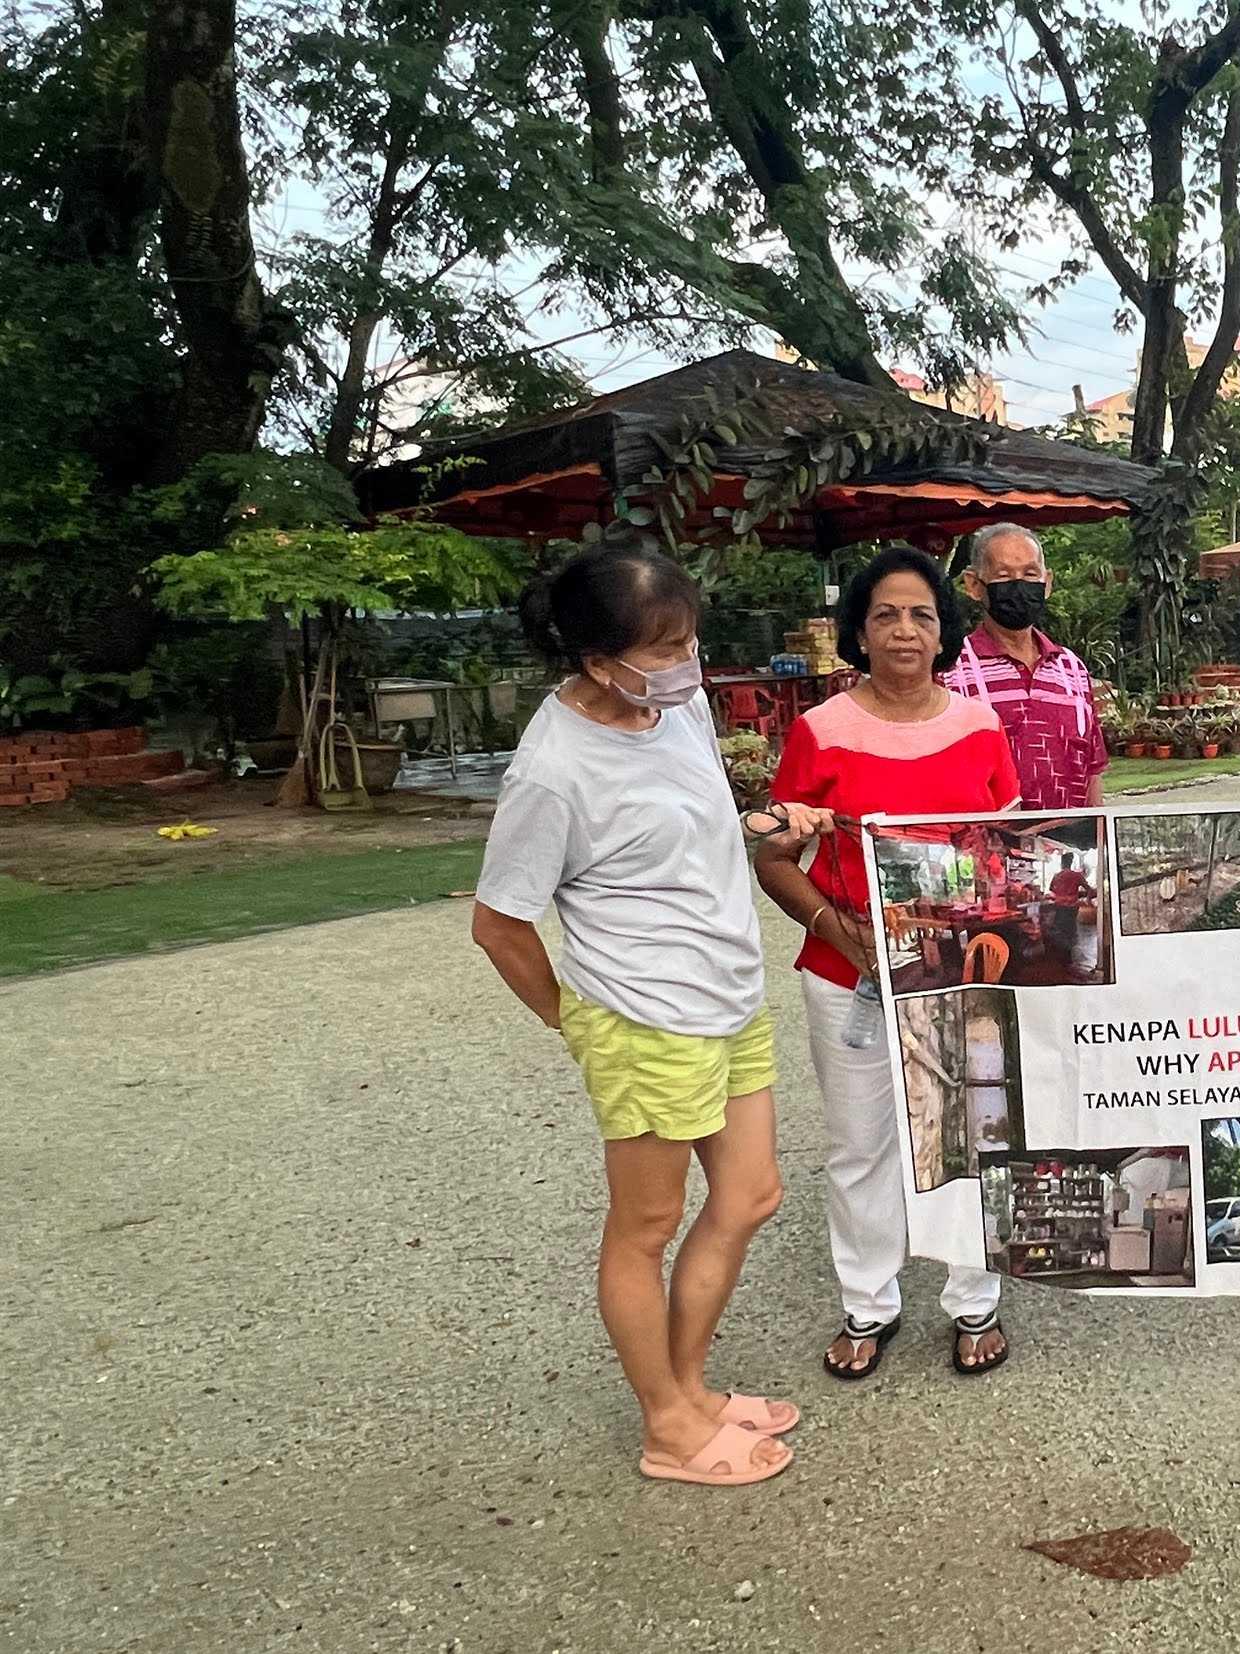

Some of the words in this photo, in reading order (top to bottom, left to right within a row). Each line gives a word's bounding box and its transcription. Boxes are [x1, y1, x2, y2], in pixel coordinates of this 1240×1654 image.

[1073, 1019, 1180, 1045] KENAPA
[1137, 1054, 1200, 1076] WHY
[1083, 1091, 1161, 1110] TAMAN
